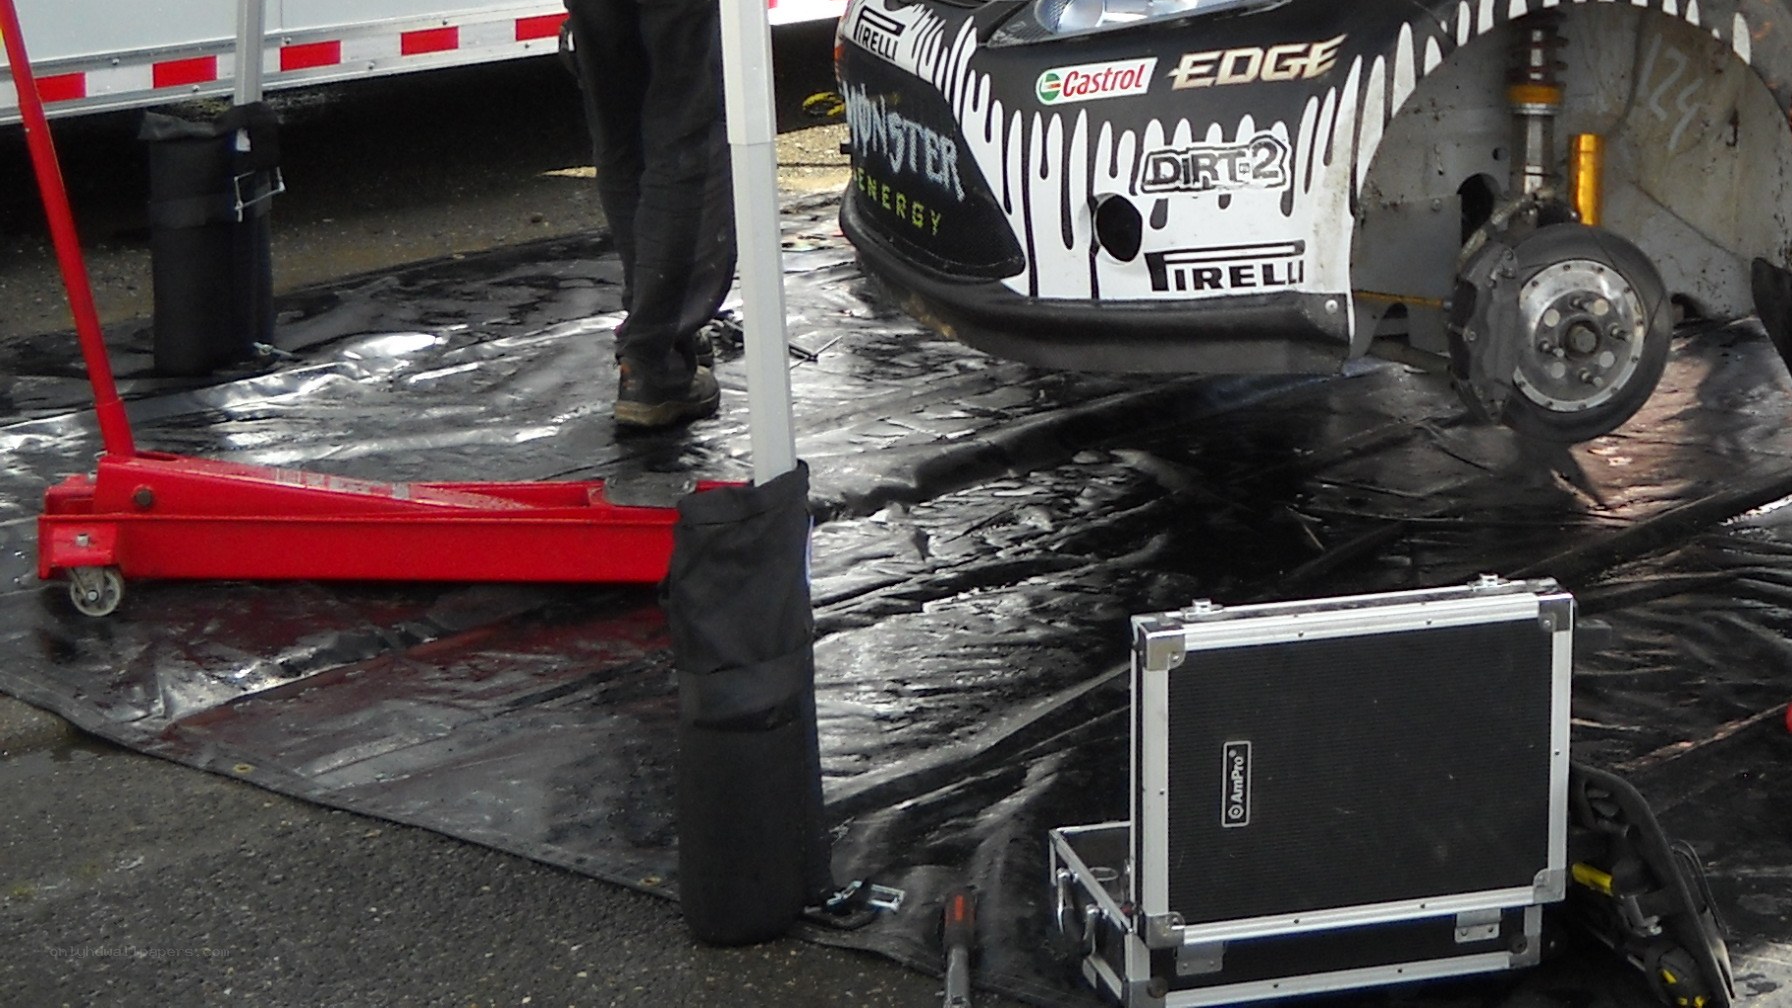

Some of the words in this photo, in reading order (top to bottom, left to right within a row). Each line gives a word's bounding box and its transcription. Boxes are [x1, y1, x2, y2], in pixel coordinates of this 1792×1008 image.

[853, 5, 906, 62] PIRELLI
[1062, 63, 1147, 98] Castrol
[1166, 33, 1348, 91] EDGE
[853, 166, 943, 238] ENERGY
[1143, 238, 1307, 293] PIRELLI
[1230, 755, 1245, 804] AmPro
